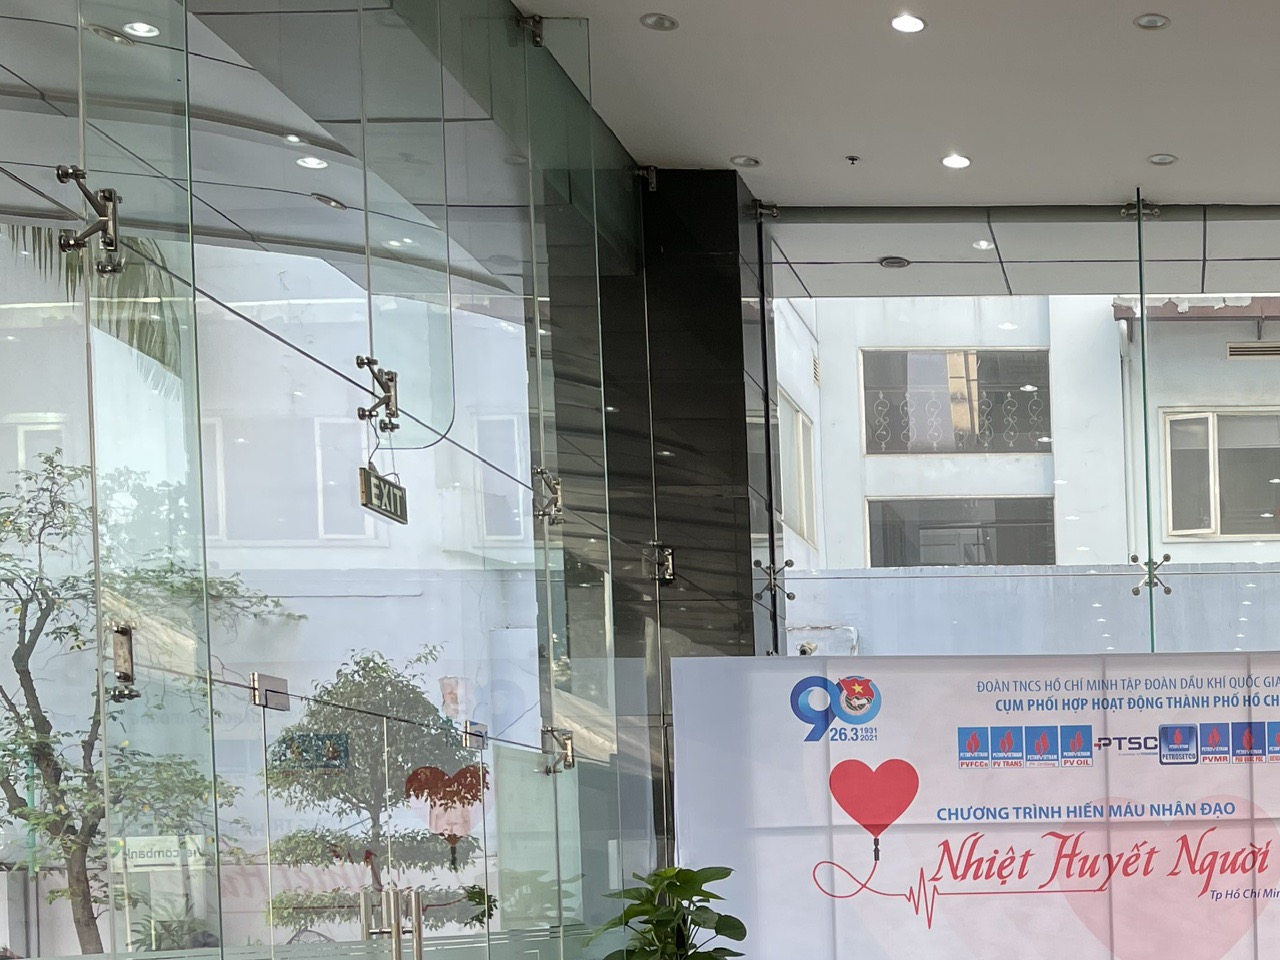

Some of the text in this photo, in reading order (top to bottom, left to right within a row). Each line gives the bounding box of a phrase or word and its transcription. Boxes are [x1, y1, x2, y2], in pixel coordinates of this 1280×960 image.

[370, 476, 404, 516] EXIT
[976, 679, 1010, 693] ĐOÀN
[1012, 680, 1041, 692] TNCS
[1064, 677, 1083, 691] CHÍ
[1086, 679, 1118, 691] MINH
[1120, 677, 1142, 693] TẬP
[1145, 675, 1177, 690] ĐOÀN
[1207, 675, 1226, 689] KHÍ
[1229, 673, 1260, 688] QUỐC
[995, 699, 1024, 714] CỤM
[1027, 695, 1058, 711] PHỐI
[1062, 698, 1089, 713] HỢP
[1091, 697, 1124, 713] HOẠT
[1127, 694, 1163, 711] ĐỘNG
[1166, 693, 1210, 709] THÀNH
[1213, 692, 1240, 708] PHỐ
[1243, 691, 1260, 707] HỒ
[829, 727, 859, 742] 26.3
[1098, 736, 1158, 750] PTSC
[1003, 760, 1023, 768] TRANS
[1162, 752, 1196, 761] PETROSETCO
[1202, 755, 1229, 763] PVMR
[936, 801, 1236, 821] CHƯƠNG TRÌNH HIẾN MÁU NHÂN ĐẠO
[928, 831, 1036, 886] Nhiệt
[1038, 830, 1161, 893] Huyết
[1166, 825, 1273, 898] Người
[1210, 889, 1223, 901] Tp
[1225, 888, 1241, 899] Hồ
[1242, 887, 1261, 899] Chí
